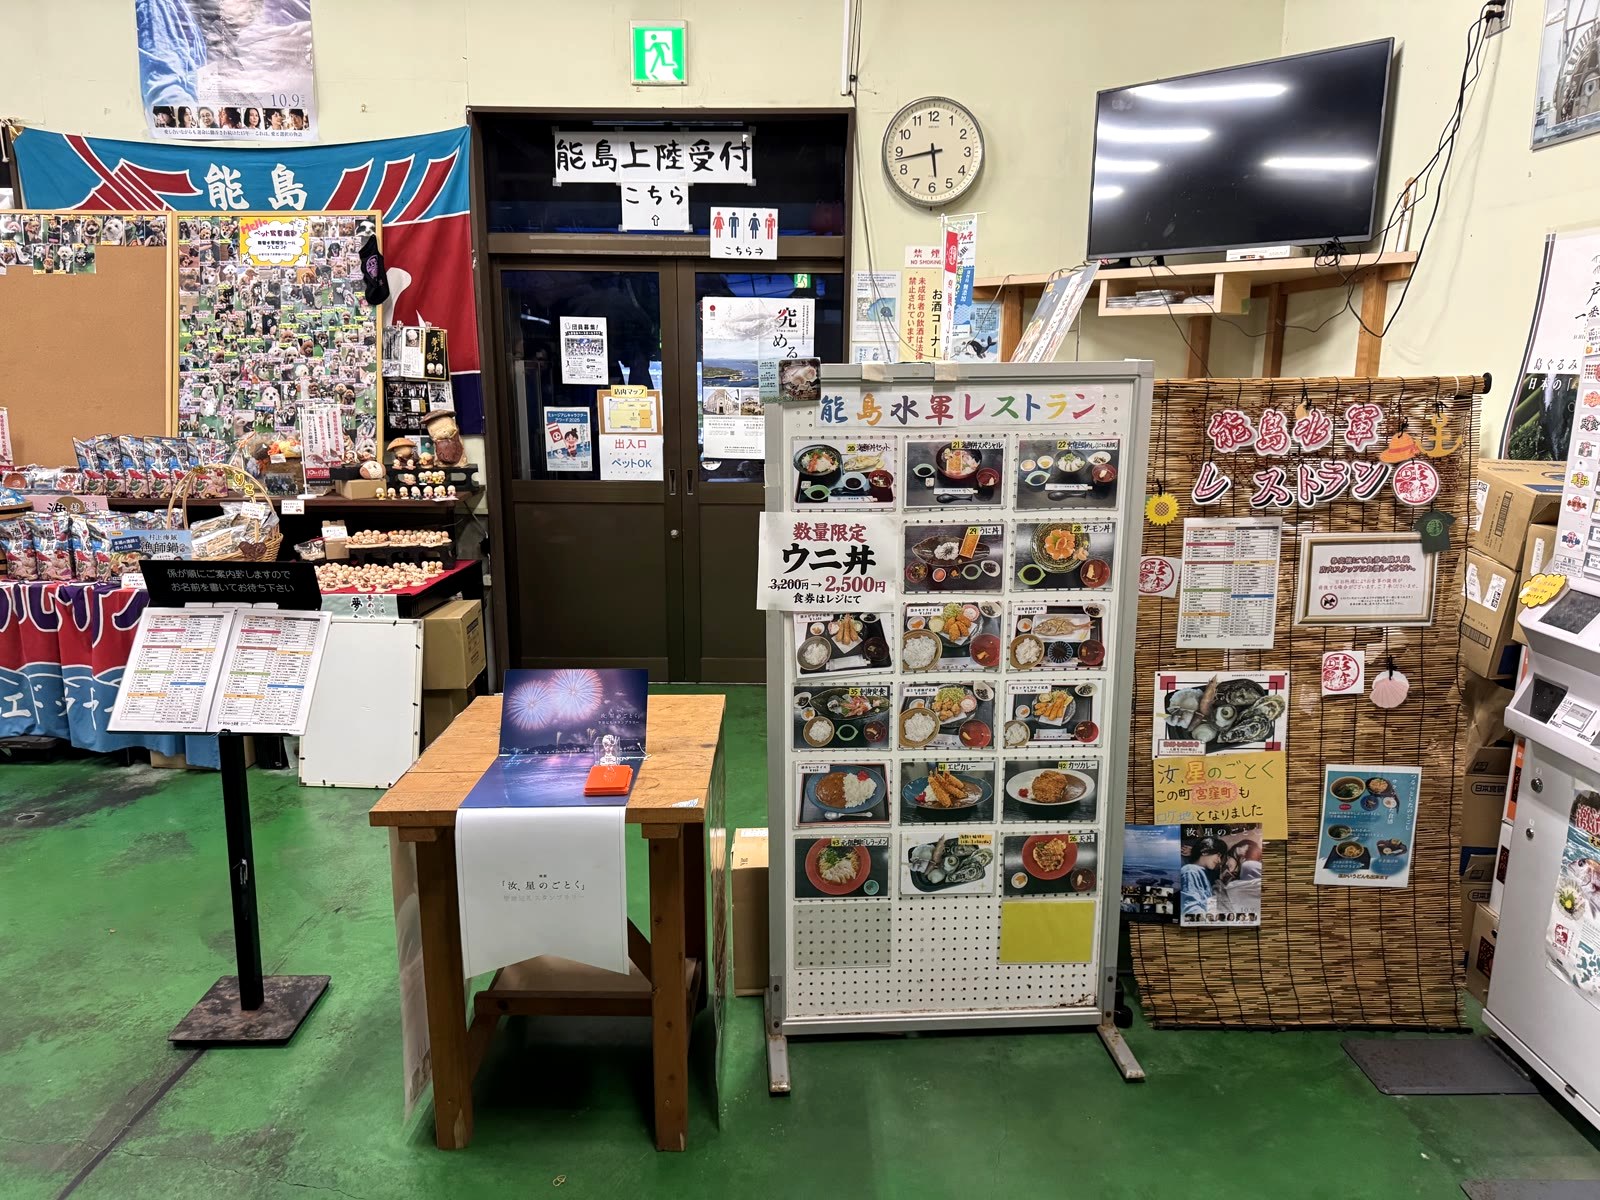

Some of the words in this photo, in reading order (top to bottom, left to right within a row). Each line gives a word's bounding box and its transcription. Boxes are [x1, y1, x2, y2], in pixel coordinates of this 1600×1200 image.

[271, 93, 300, 107] 10.9
[912, 115, 922, 126] 11
[928, 111, 940, 122] 12
[949, 115, 954, 126] 1
[899, 129, 911, 140] 10
[959, 129, 967, 140] 2
[556, 138, 750, 173] 能島上陸受付
[895, 146, 903, 157] 9
[963, 147, 971, 157] 3
[900, 164, 908, 175] 8
[957, 165, 966, 176] 4
[204, 163, 308, 211] 能島
[912, 178, 920, 189] 7
[928, 182, 936, 193] 6
[945, 178, 953, 189] 5
[625, 185, 685, 205] こちら
[724, 246, 753, 256] こちら
[914, 248, 940, 259] 禁煙
[915, 277, 926, 360] 未成年者の飲酒は法律
[931, 289, 943, 358] お酒コーナー
[820, 392, 1096, 426] 能島水軍レストラン
[1209, 404, 1382, 453] 能島水軍
[614, 438, 647, 450] 出入口
[952, 441, 960, 449] 21
[1058, 440, 1067, 449] 22
[612, 458, 652, 468] ペットOK
[1193, 460, 1391, 507] レストラン
[793, 521, 868, 543] 数量限定
[980, 526, 999, 534] うに丼
[1083, 524, 1111, 533] サーモン丼
[782, 543, 877, 575] ウニ丼
[171, 583, 295, 593] お名前を書いてお待ち下さい
[768, 578, 809, 591] 3,200円
[825, 575, 886, 593] 2,500円
[793, 592, 862, 604] 食券はレジにて
[948, 763, 976, 771] エビカレー
[1157, 760, 1274, 785] 汝、星のごとく
[1156, 804, 1264, 822] ロケ地となりました
[502, 880, 585, 891] 「汝、星のごとく」
